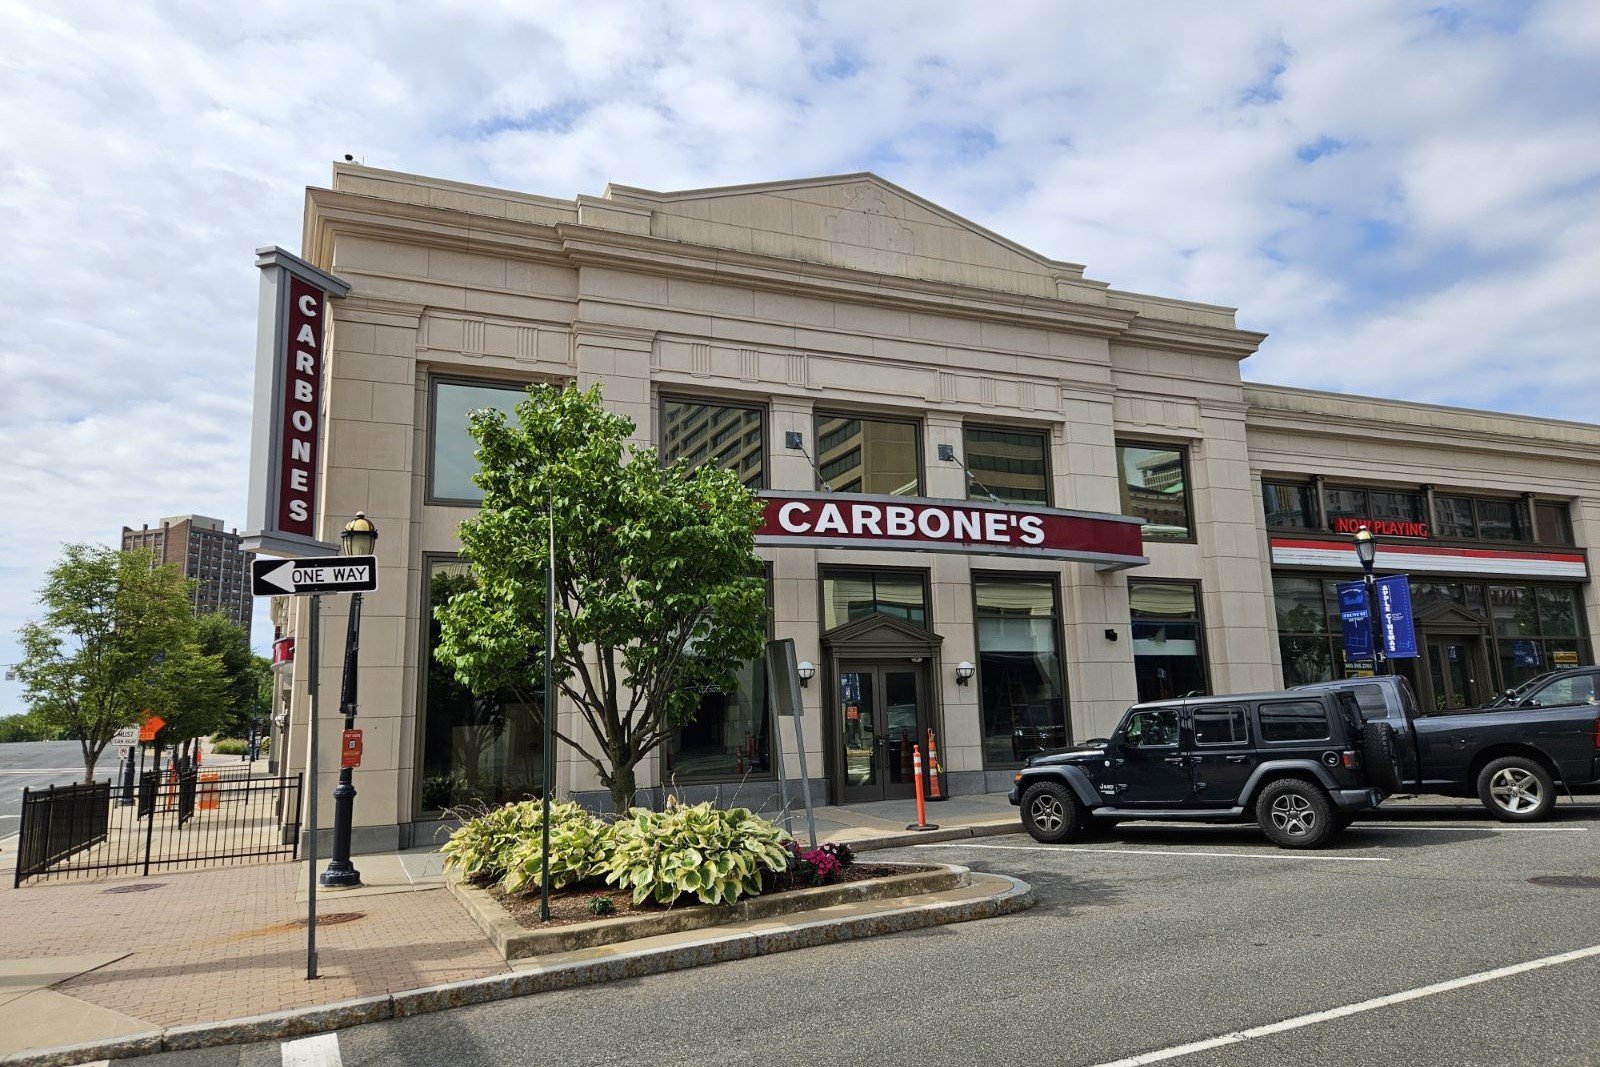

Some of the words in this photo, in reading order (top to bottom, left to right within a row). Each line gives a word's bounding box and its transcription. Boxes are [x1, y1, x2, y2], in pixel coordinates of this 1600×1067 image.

[288, 294, 317, 522] CARBONES
[778, 501, 1045, 545] CARBONE'S
[1338, 518, 1370, 533] NOW
[1374, 521, 1428, 537] PLAYING
[291, 568, 325, 584] ONE
[333, 565, 368, 582] WAY
[1382, 585, 1391, 612] APPLE
[1386, 613, 1396, 652] CINEMAS
